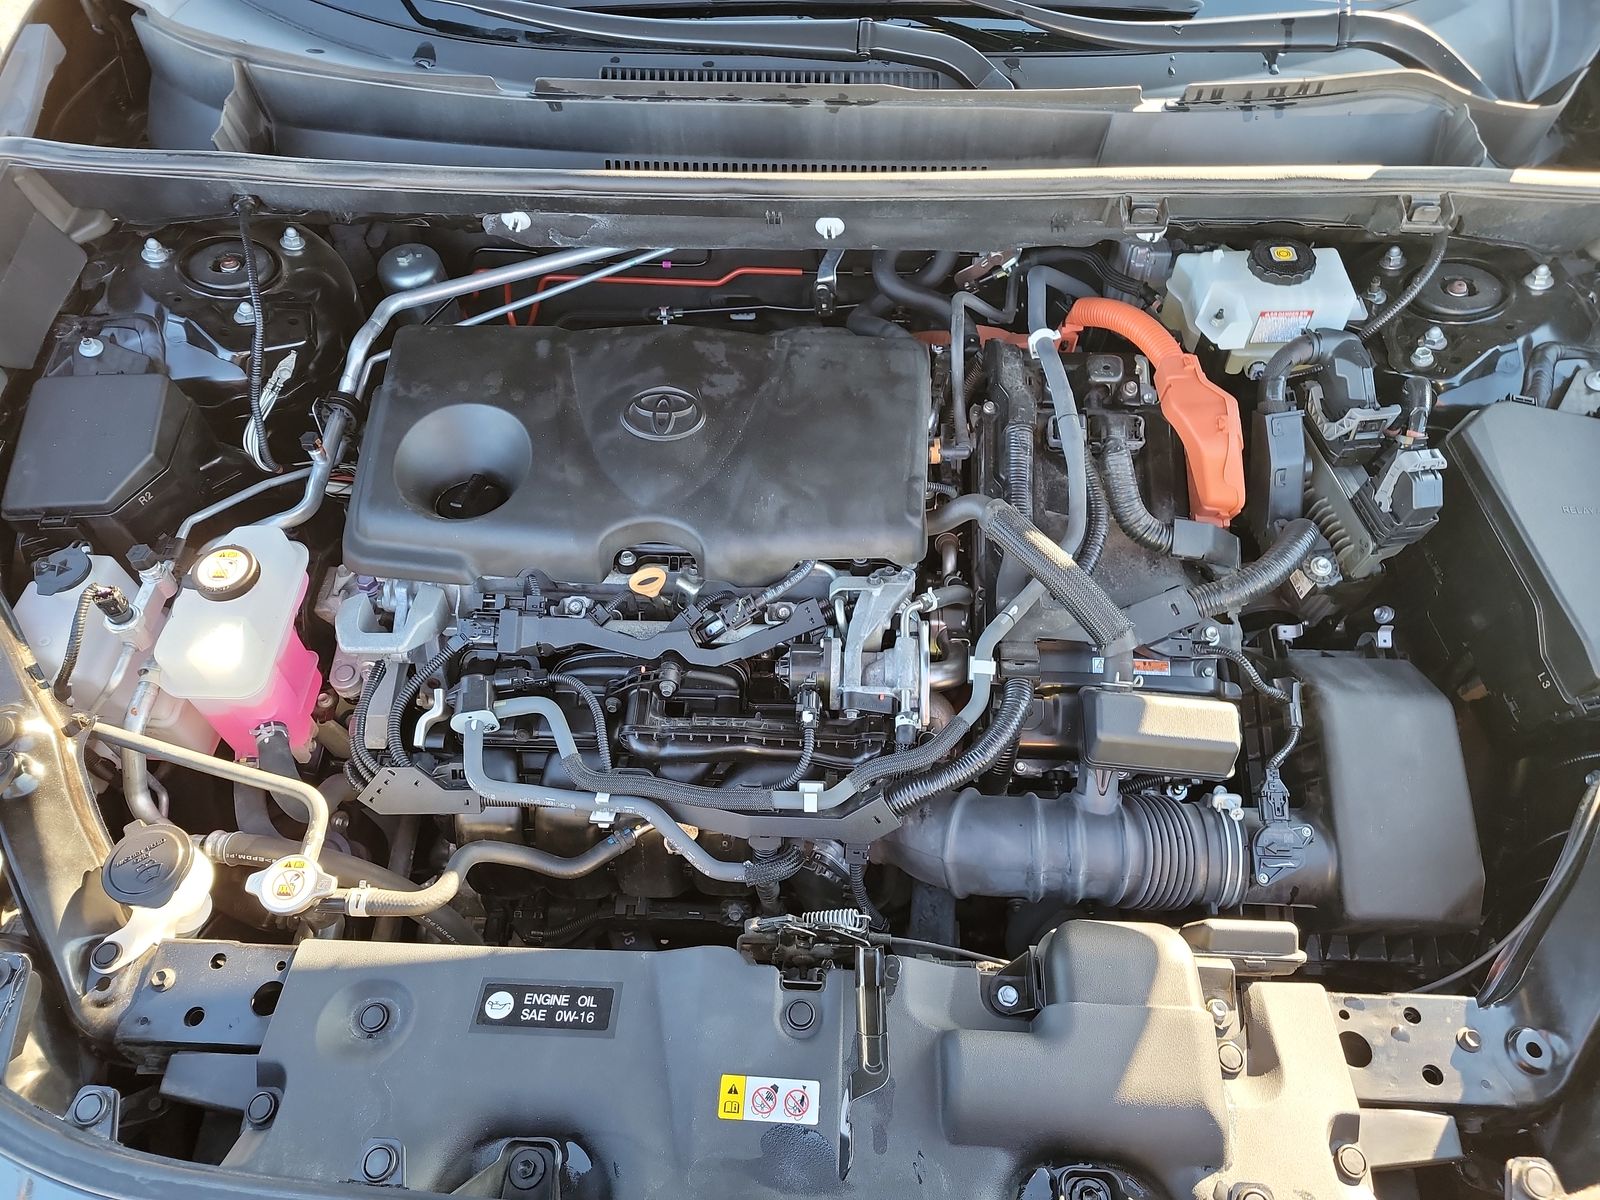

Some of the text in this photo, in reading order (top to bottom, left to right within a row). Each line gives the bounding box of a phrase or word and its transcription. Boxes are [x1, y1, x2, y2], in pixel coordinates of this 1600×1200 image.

[138, 491, 154, 506] R2
[1536, 671, 1551, 689] L3
[523, 993, 598, 1008] ENGINE OIL
[520, 1008, 595, 1023] SAE 0W-16
